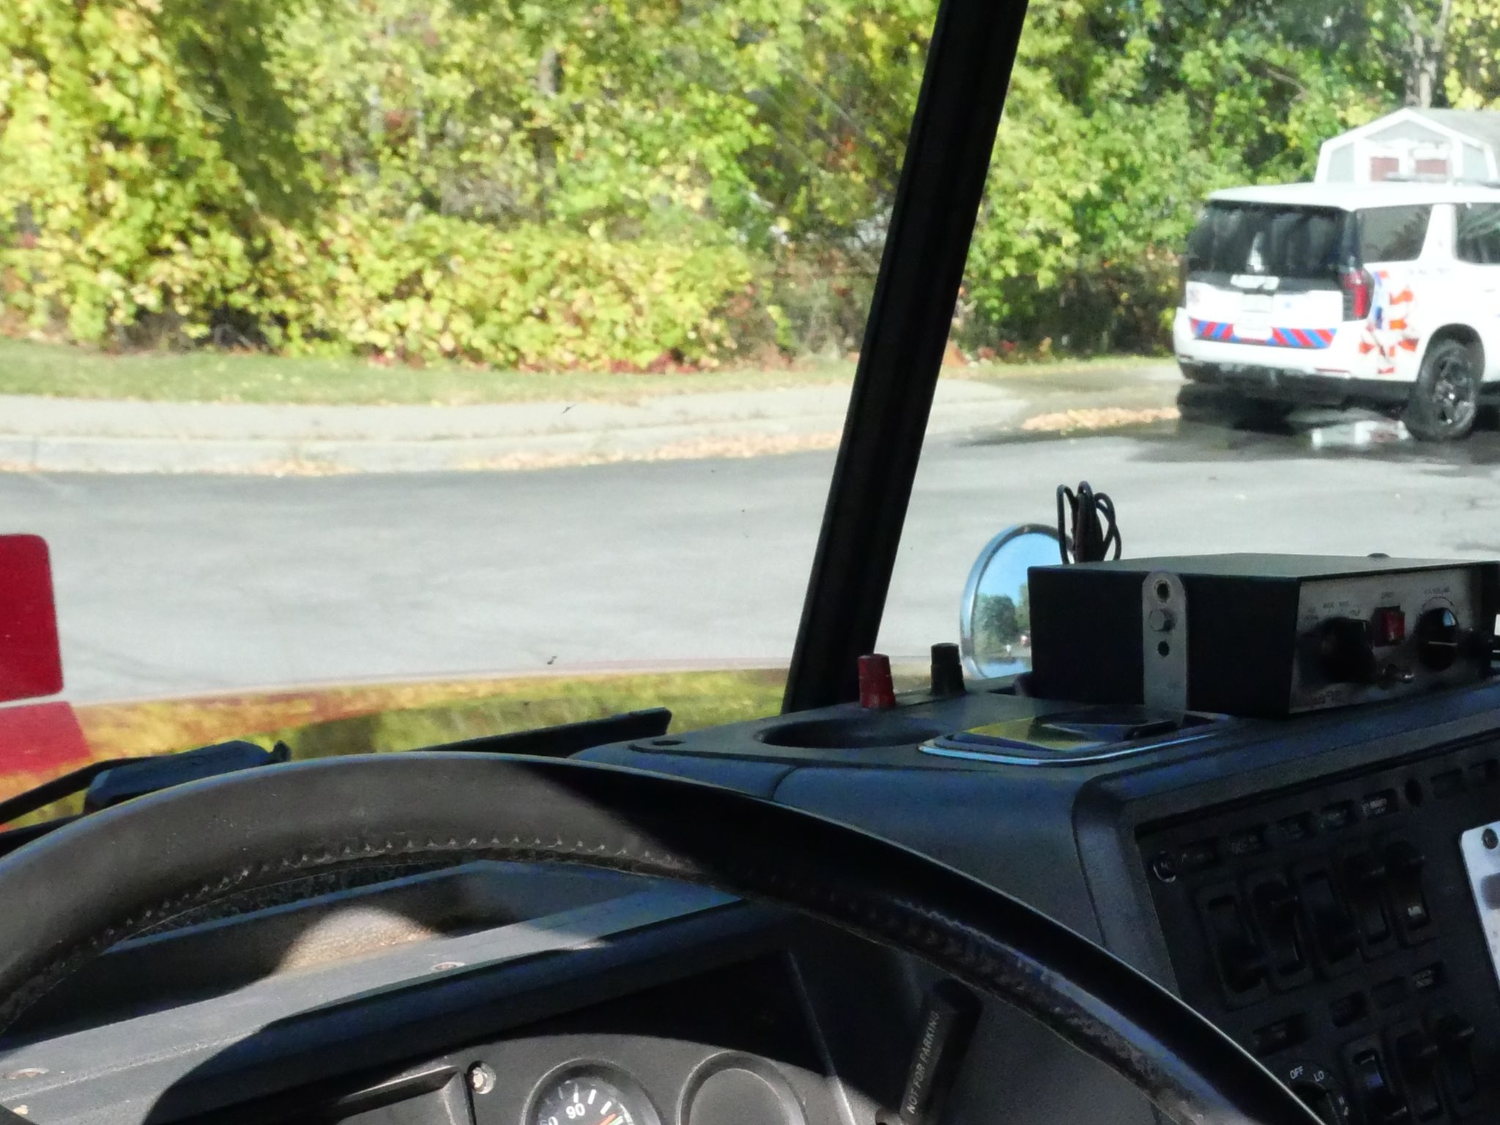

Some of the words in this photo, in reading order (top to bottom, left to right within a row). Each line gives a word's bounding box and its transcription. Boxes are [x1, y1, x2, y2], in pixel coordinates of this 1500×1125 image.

[906, 1089, 920, 1114] NOT
[913, 1063, 925, 1088] FOR
[919, 1010, 940, 1062] PARKING
[1289, 1065, 1304, 1080] OFF
[1313, 1070, 1325, 1083] LO
[565, 1103, 586, 1119] 90
